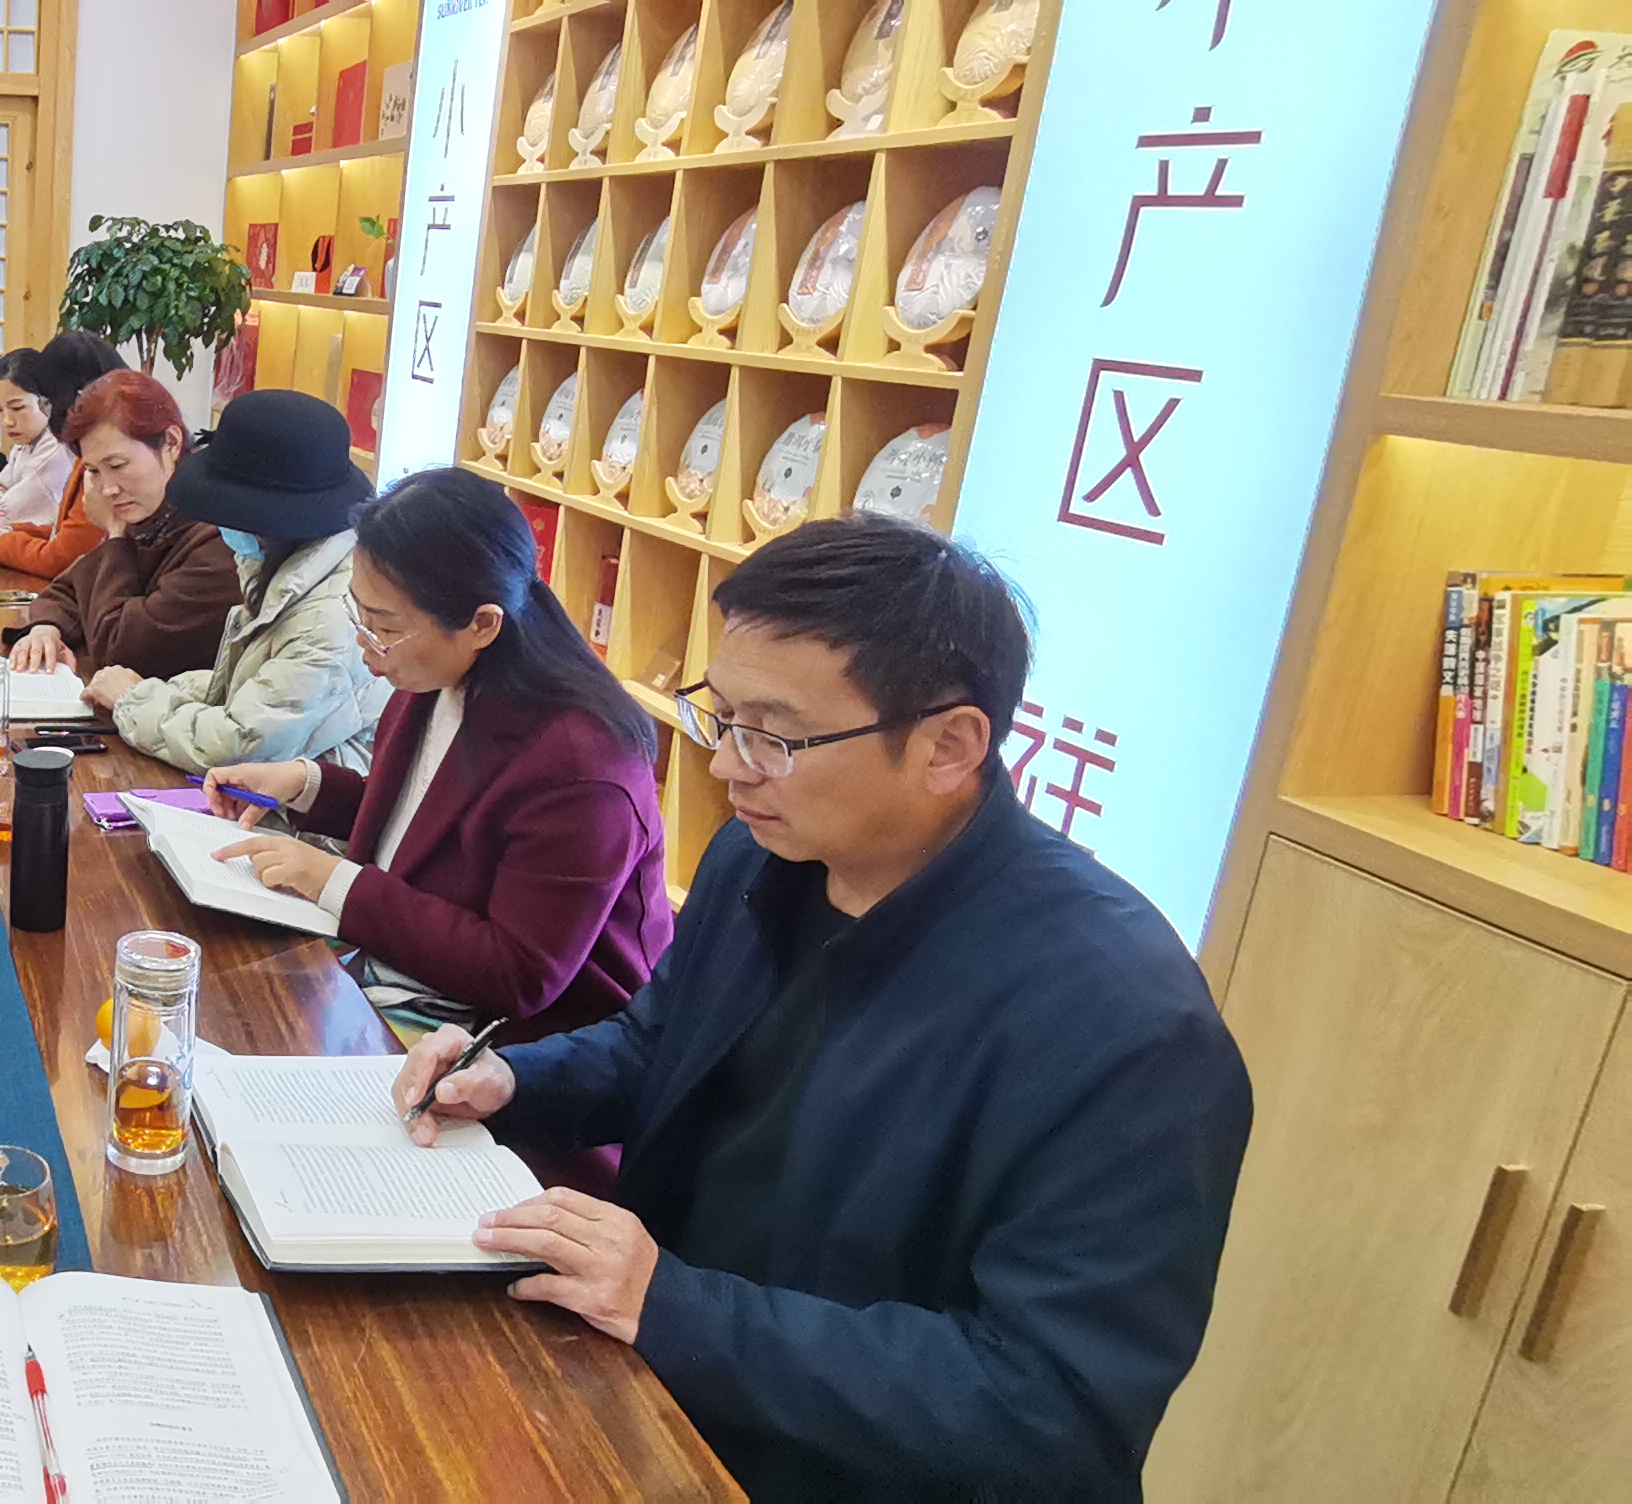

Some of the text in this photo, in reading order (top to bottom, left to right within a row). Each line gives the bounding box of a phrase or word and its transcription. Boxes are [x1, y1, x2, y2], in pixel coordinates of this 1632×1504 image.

[411, 59, 466, 384] 小产区
[1057, 0, 1265, 546] 产区
